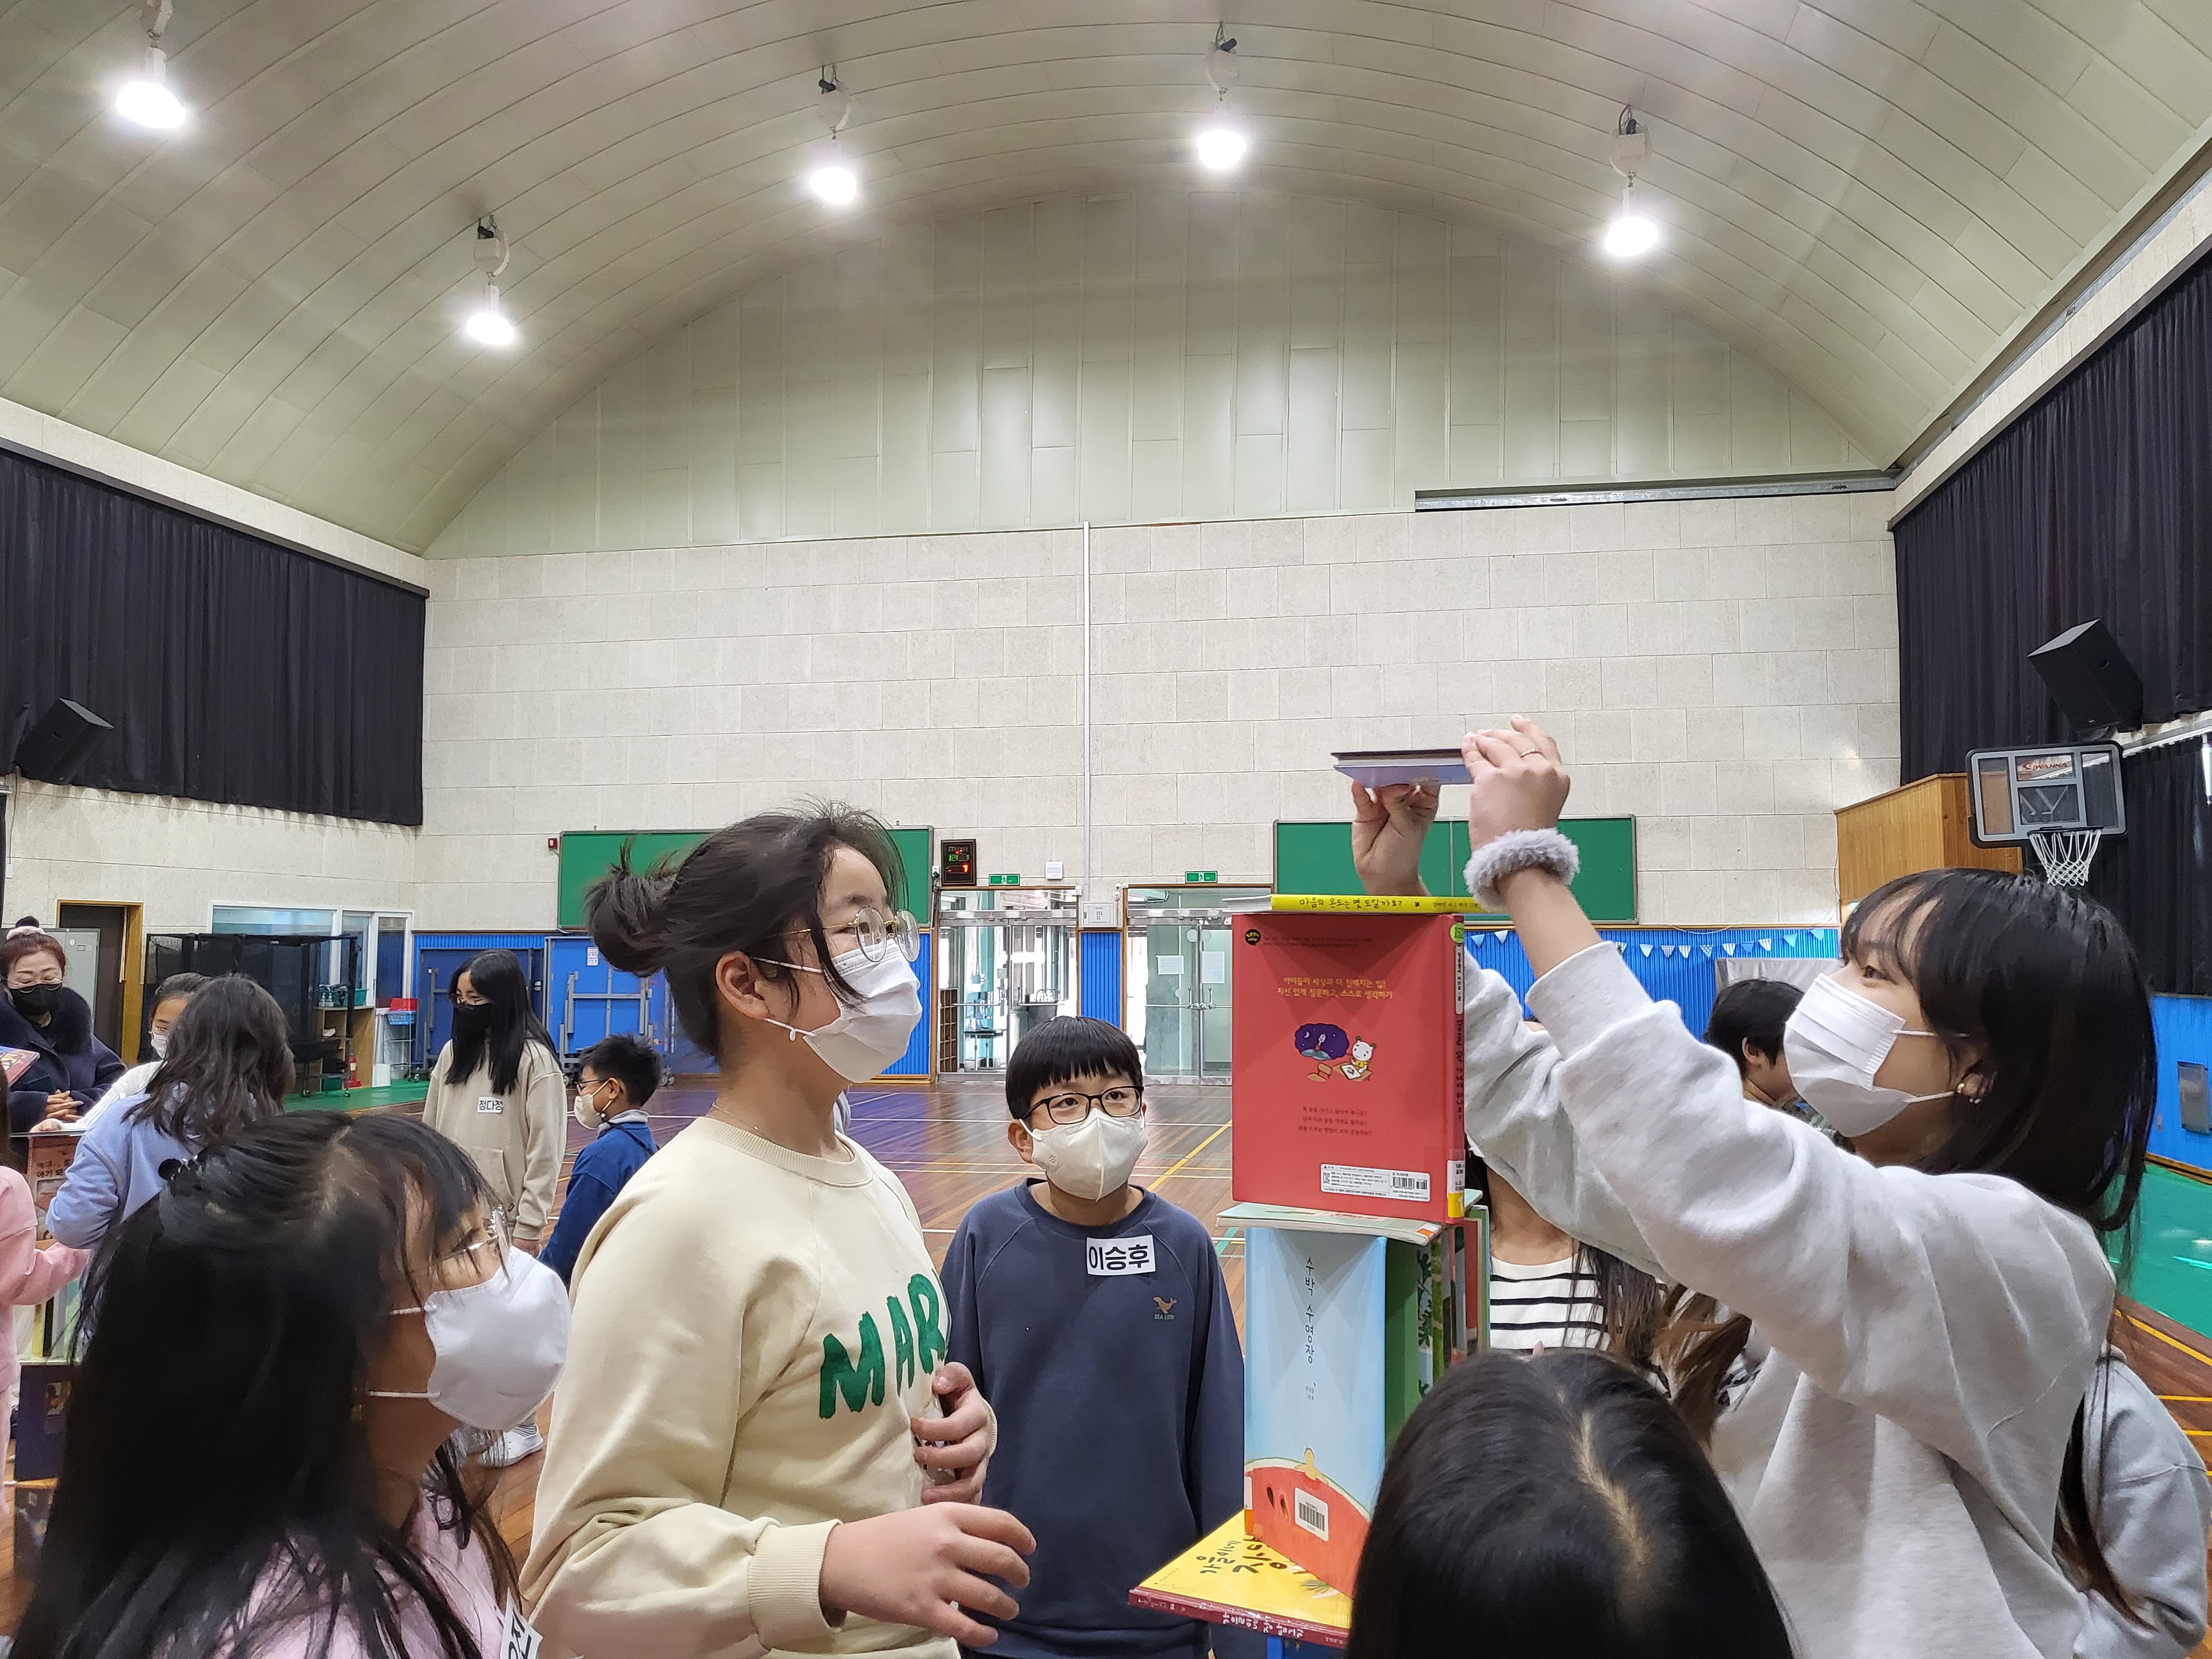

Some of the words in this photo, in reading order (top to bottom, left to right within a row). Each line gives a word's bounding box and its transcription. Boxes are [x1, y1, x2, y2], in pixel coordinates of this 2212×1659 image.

[1300, 898, 1323, 908] 마음의
[1329, 898, 1350, 909] 온도는
[1353, 899, 1361, 910] 몇
[1364, 898, 1402, 909] 도일까요?
[1277, 988, 1290, 997] 자신
[1293, 988, 1307, 997] 있게
[1364, 990, 1393, 999] 생각하기
[1284, 977, 1310, 986] 아이들이
[1313, 978, 1333, 987] 세상과
[1345, 978, 1373, 988] 친해지는
[479, 1100, 503, 1110] 정다정
[1088, 1244, 1150, 1270] 이승후
[1306, 1256, 1315, 1297] 수박
[819, 1268, 951, 1420] MAR
[1305, 1304, 1315, 1364] 수영장
[1196, 1540, 1242, 1574] 가을이네
[1223, 1611, 1259, 1630] 가을이네
[1262, 1620, 1274, 1634] 장
[1276, 1623, 1305, 1638] 담그기
